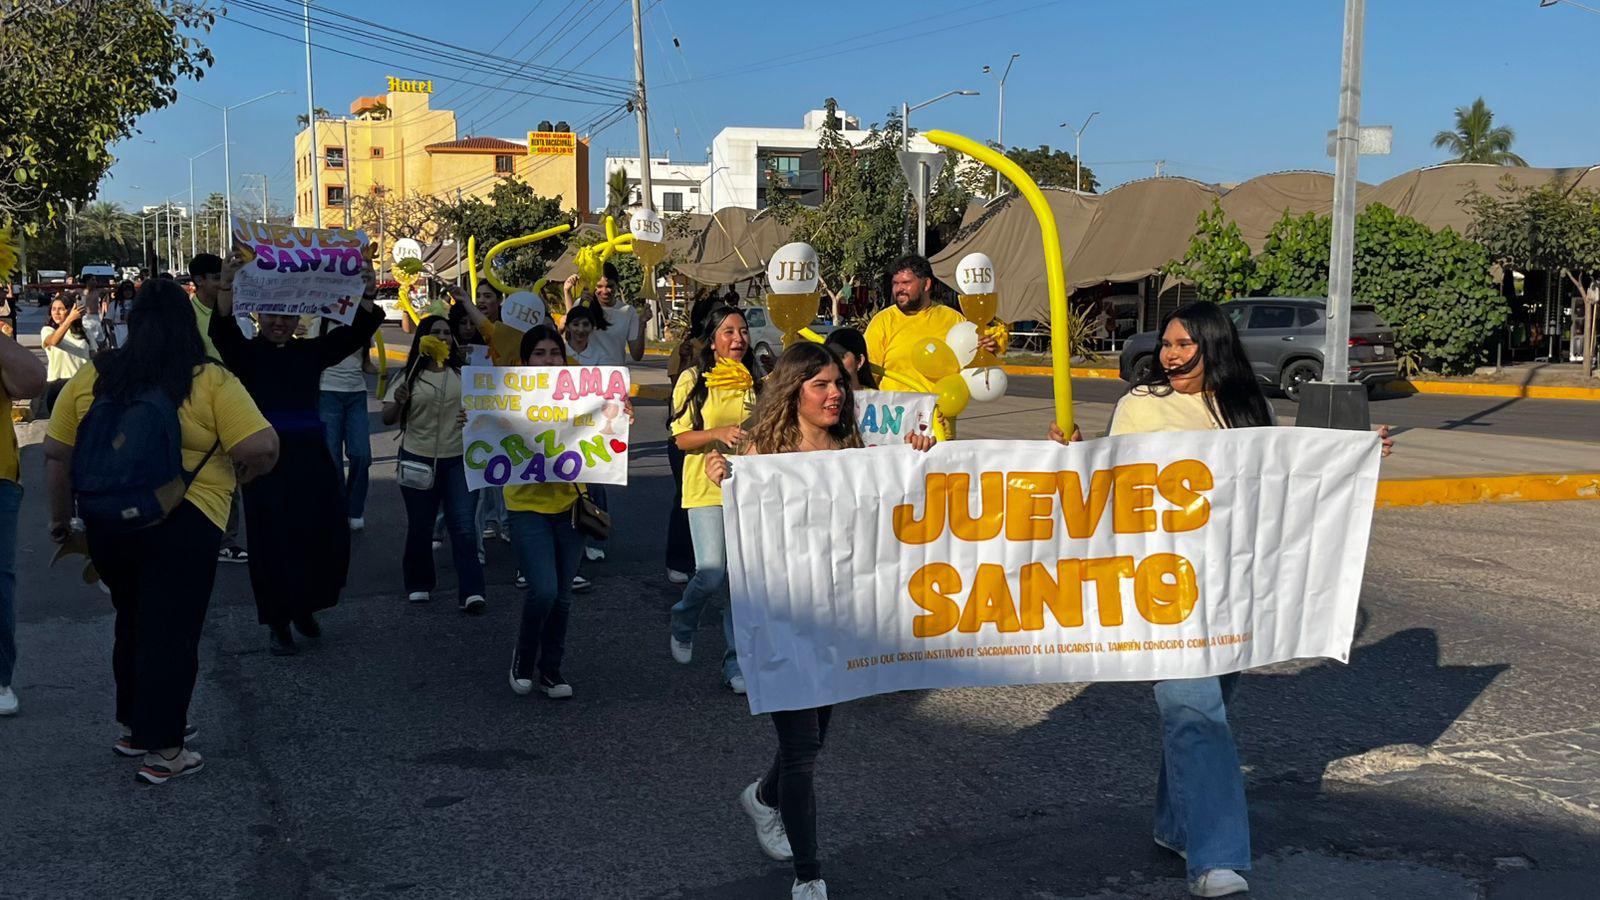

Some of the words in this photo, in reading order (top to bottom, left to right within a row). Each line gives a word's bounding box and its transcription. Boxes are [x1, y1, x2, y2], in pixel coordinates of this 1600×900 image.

[386, 76, 433, 93] Hotel
[234, 221, 361, 248] JUEVES
[635, 219, 660, 234] JHS
[255, 245, 362, 276] SANTO
[776, 261, 816, 281] JHS
[963, 267, 992, 284] JHS
[507, 302, 541, 325] JHS
[474, 373, 496, 389] EL
[504, 372, 549, 392] QUE
[552, 367, 627, 401] AMA
[463, 395, 521, 411] SIRVE
[527, 405, 568, 422] CON
[573, 413, 595, 427] EL
[892, 459, 1214, 545] JUEVES
[908, 552, 1198, 638] SANTO
[880, 653, 896, 664] QUE
[897, 650, 923, 662] CRISTO
[966, 647, 974, 657] EL
[977, 644, 1031, 657] SACRAMENTO
[1033, 645, 1042, 655] DE
[1045, 644, 1055, 654] LA
[1108, 638, 1141, 651] TAMBIÉN
[1143, 639, 1184, 651] CONOCIDO
